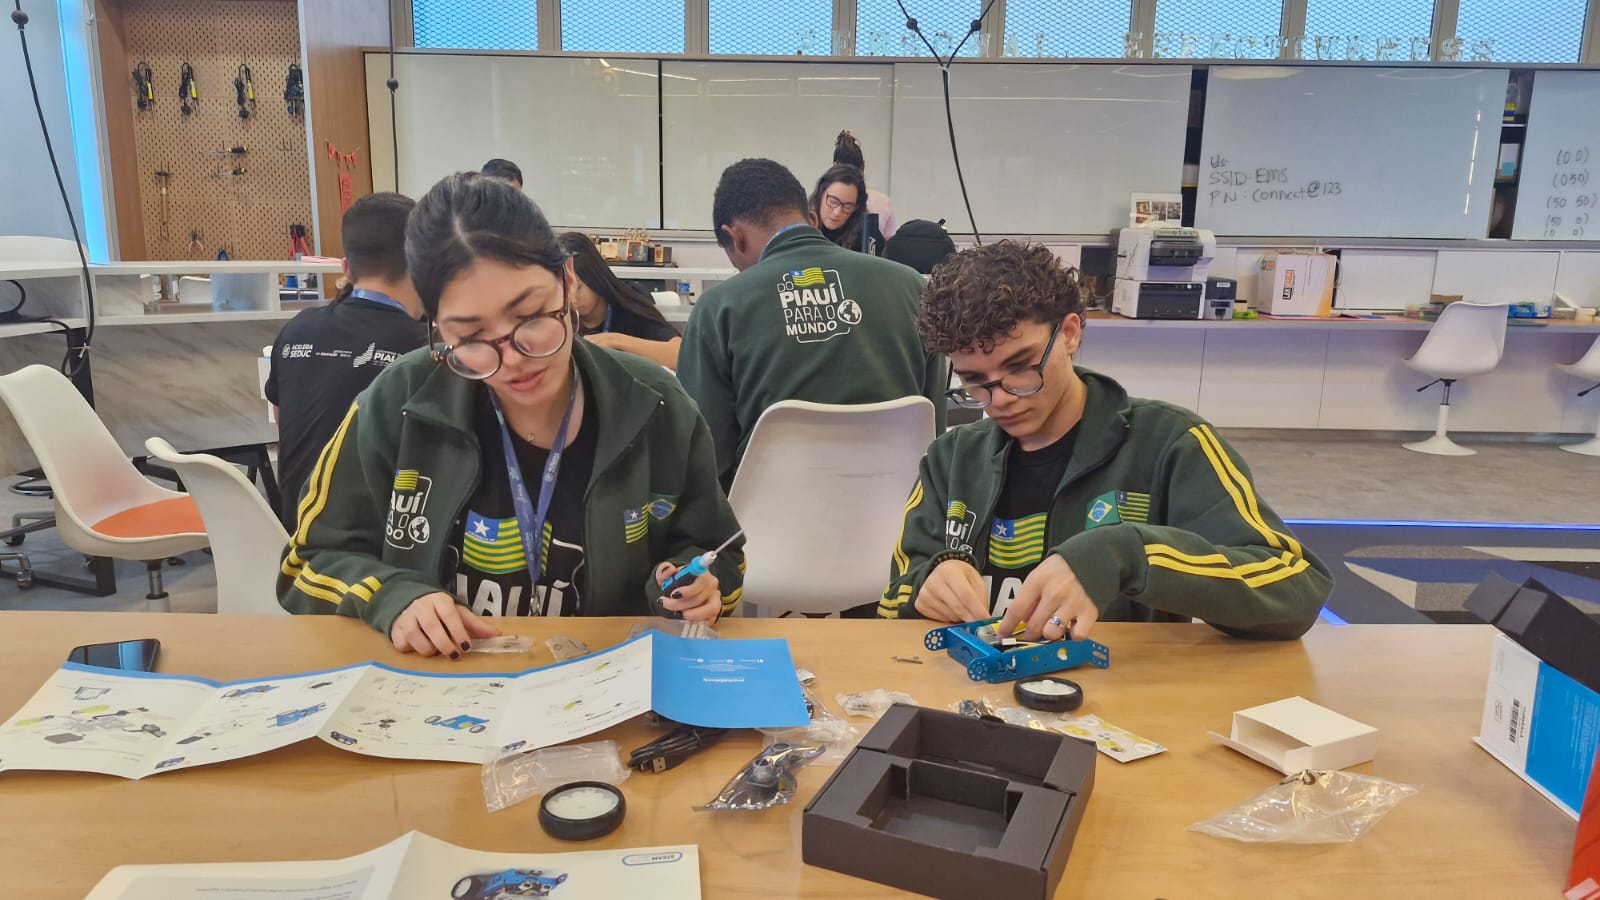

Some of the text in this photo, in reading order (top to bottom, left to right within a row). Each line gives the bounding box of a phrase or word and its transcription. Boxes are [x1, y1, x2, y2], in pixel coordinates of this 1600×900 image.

[777, 281, 794, 292] DO
[779, 282, 839, 309] PIAUÍ
[783, 304, 836, 324] PARA O
[785, 320, 838, 336] MUNDO
[289, 350, 312, 358] SEDUC
